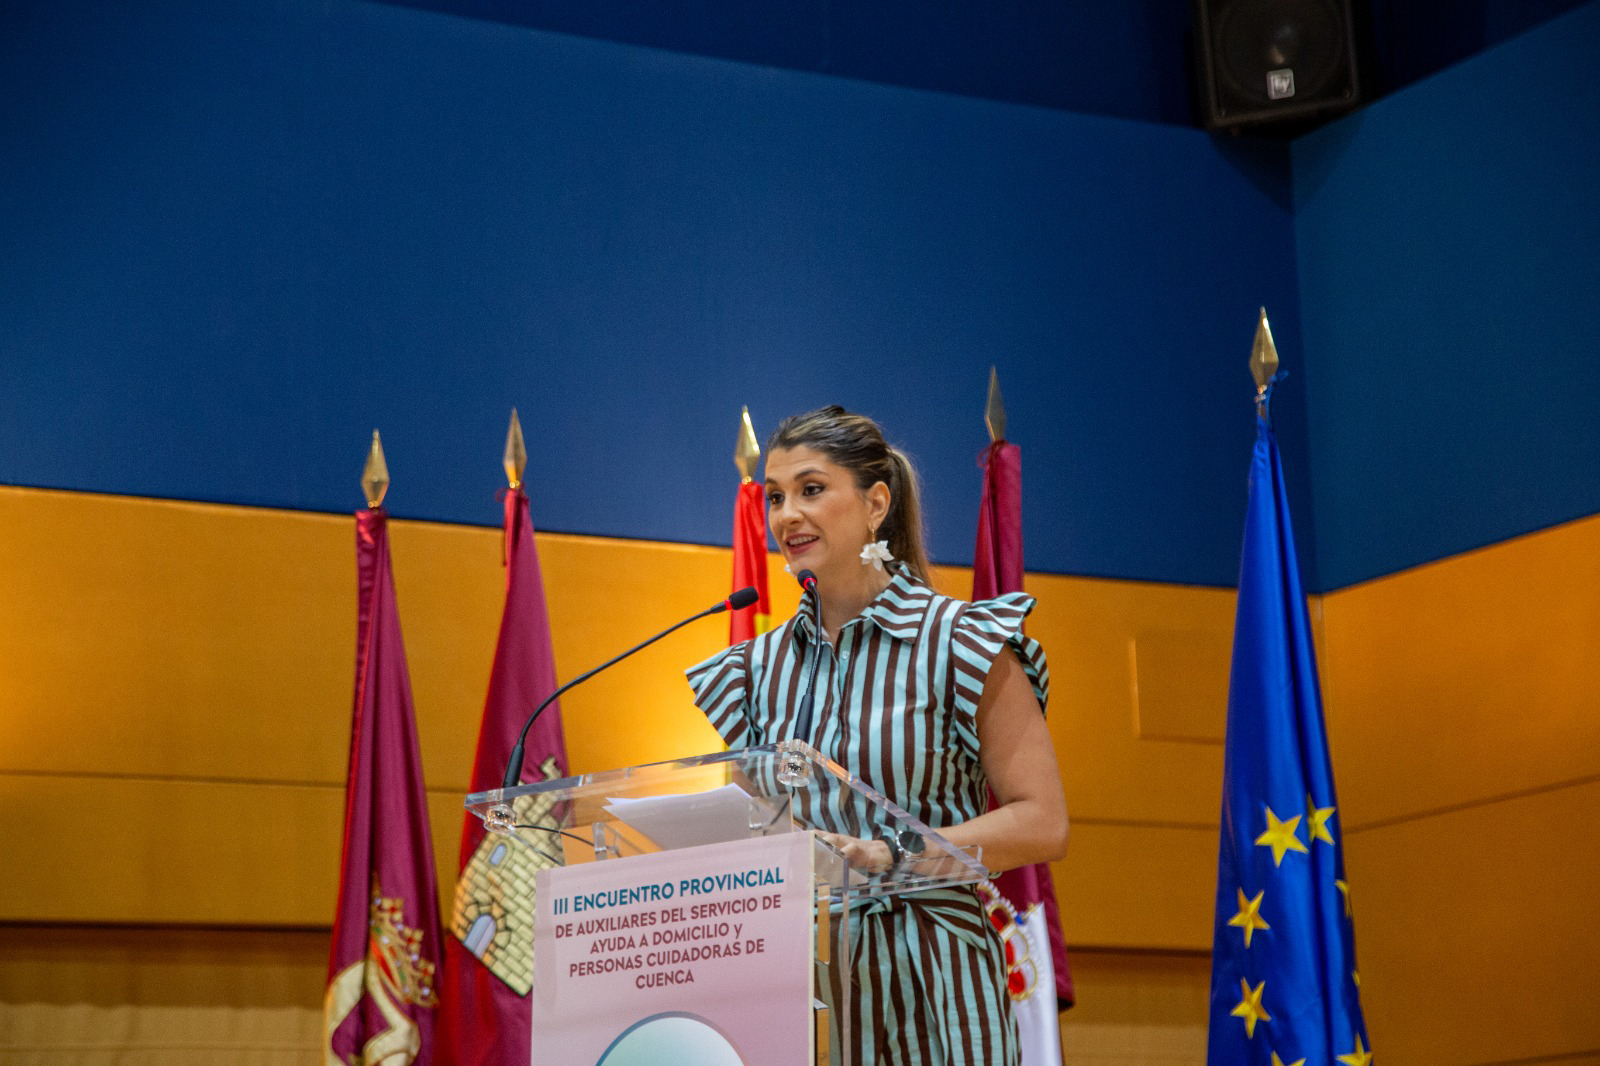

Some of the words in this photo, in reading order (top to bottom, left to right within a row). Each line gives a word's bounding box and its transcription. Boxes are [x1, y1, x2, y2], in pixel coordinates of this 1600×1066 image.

[554, 898, 568, 915] III
[574, 882, 674, 912] ENCUENTRO
[680, 867, 784, 897] PROVINCIAL
[555, 924, 573, 939] DE
[576, 912, 657, 936] AUXILIARES
[661, 908, 687, 924] DEL
[691, 899, 758, 919] SERVICIO
[762, 894, 782, 910] DE
[569, 955, 643, 977] PERSONAS
[647, 941, 742, 967] CUIDADORAS
[746, 938, 765, 955] DE
[590, 935, 636, 954] AYUDA
[639, 932, 649, 947] A
[653, 922, 730, 946] DOMICILIO
[635, 969, 694, 989] CUENCA
